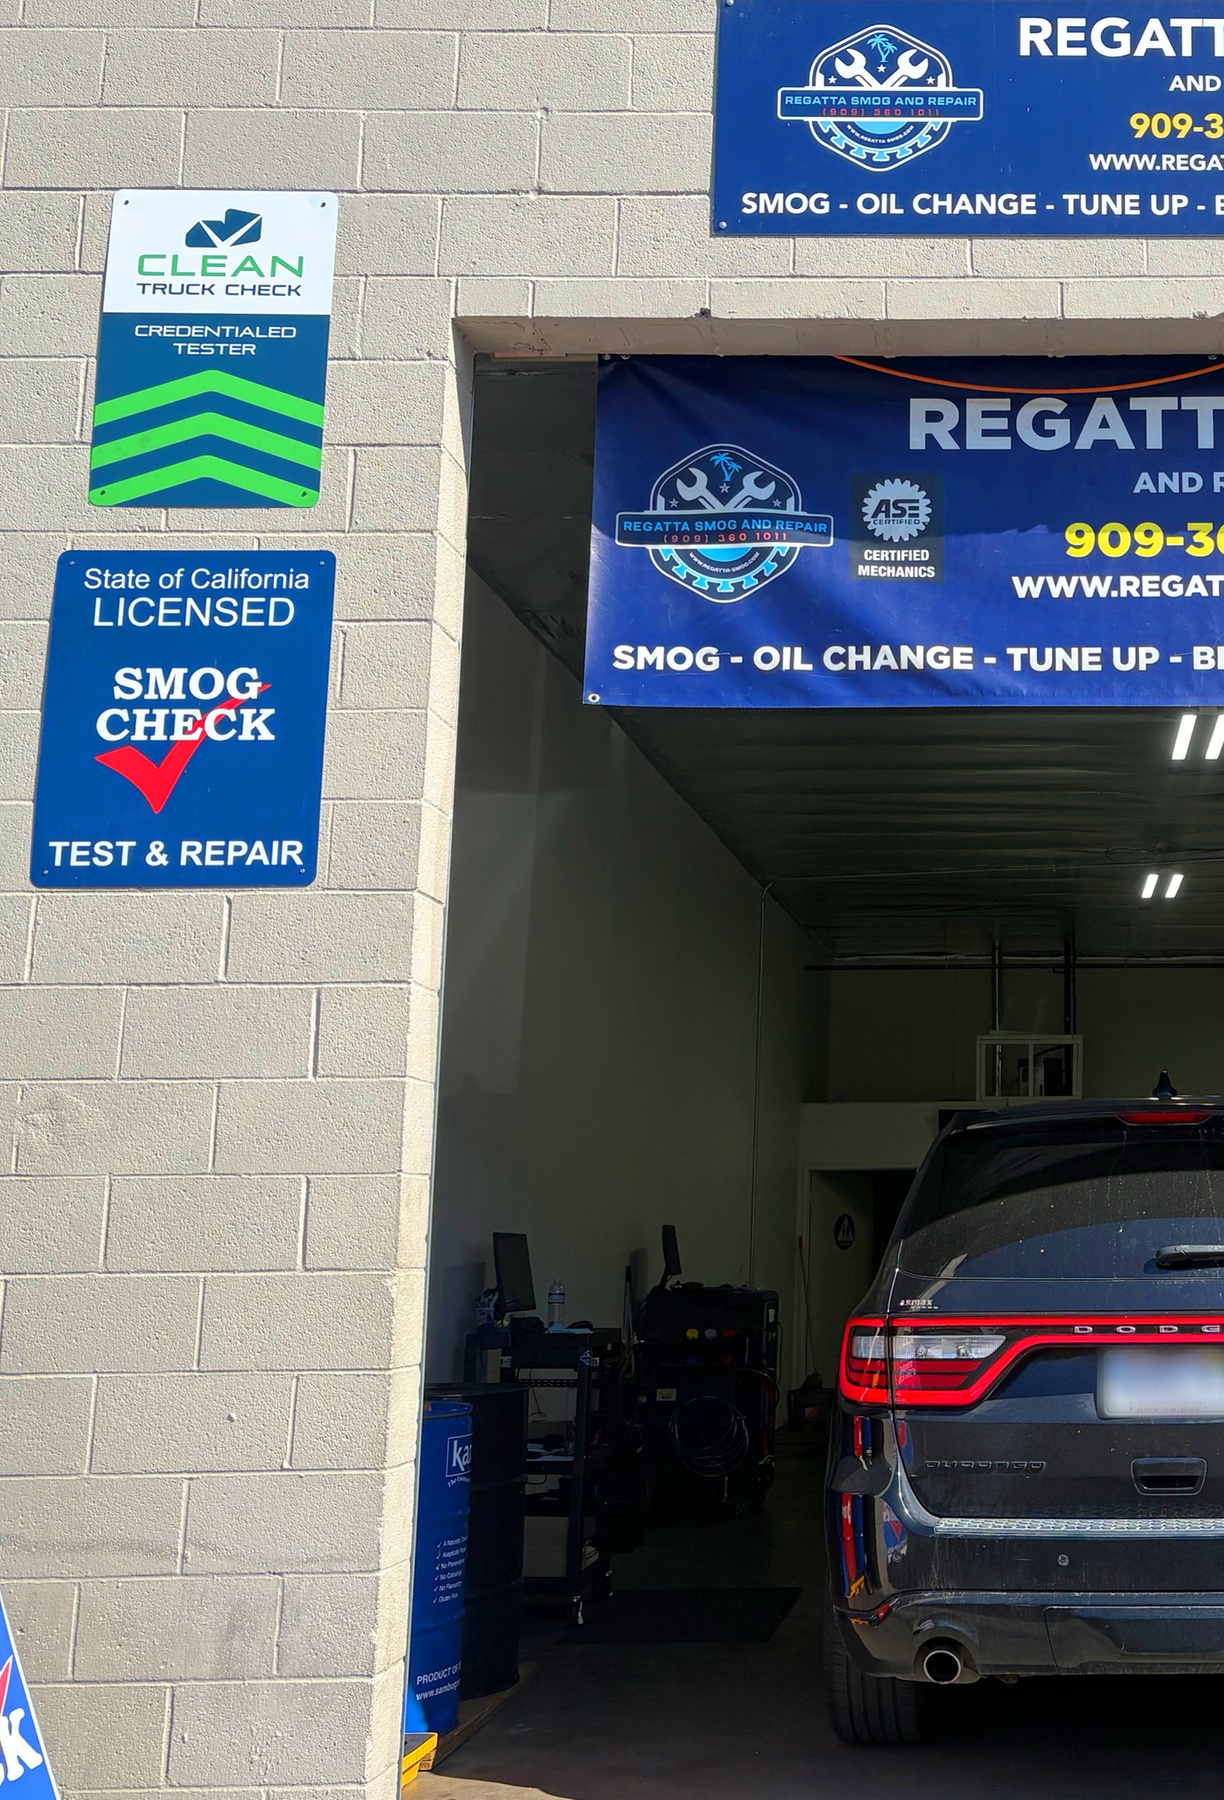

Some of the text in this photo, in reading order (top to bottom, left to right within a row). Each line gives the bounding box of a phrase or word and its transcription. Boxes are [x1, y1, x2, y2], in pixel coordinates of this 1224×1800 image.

[1168, 74, 1222, 92] AND
[784, 95, 977, 106] REGATTA SMOG AND REPAIR
[741, 192, 830, 215] SMOG
[856, 192, 904, 215] OIL
[912, 193, 1037, 215] CHANGE
[1062, 194, 1141, 216] TUNE
[1150, 194, 1189, 216] UP
[138, 254, 304, 278] CLEAN
[136, 283, 302, 297] TRUCK CHECK
[134, 325, 297, 339] CREDENTIALED
[172, 342, 257, 356] TESTER
[1132, 471, 1204, 494] AND
[871, 499, 927, 519] ASE
[623, 519, 828, 533] REGATTA SMOG AND REPAIR
[718, 533, 747, 543] 360
[755, 532, 788, 541] 1011
[863, 549, 930, 561] CERTIFIED
[84, 567, 309, 590] State of California
[857, 564, 936, 578] MECHANICS
[93, 597, 295, 627] LICENSED
[612, 644, 720, 672] SMOG
[753, 645, 814, 672] OIL
[822, 644, 974, 672] CHANGE
[1006, 646, 1103, 672] TUNE
[1112, 646, 1160, 672] UP
[113, 667, 262, 701] SMOG
[96, 708, 275, 741] CHECK
[48, 840, 304, 867] TEST & REPAIR
[452, 1439, 473, 1472] ka
[923, 1460, 1046, 1474] DURANGO
[416, 1666, 452, 1685] PRODUCT
